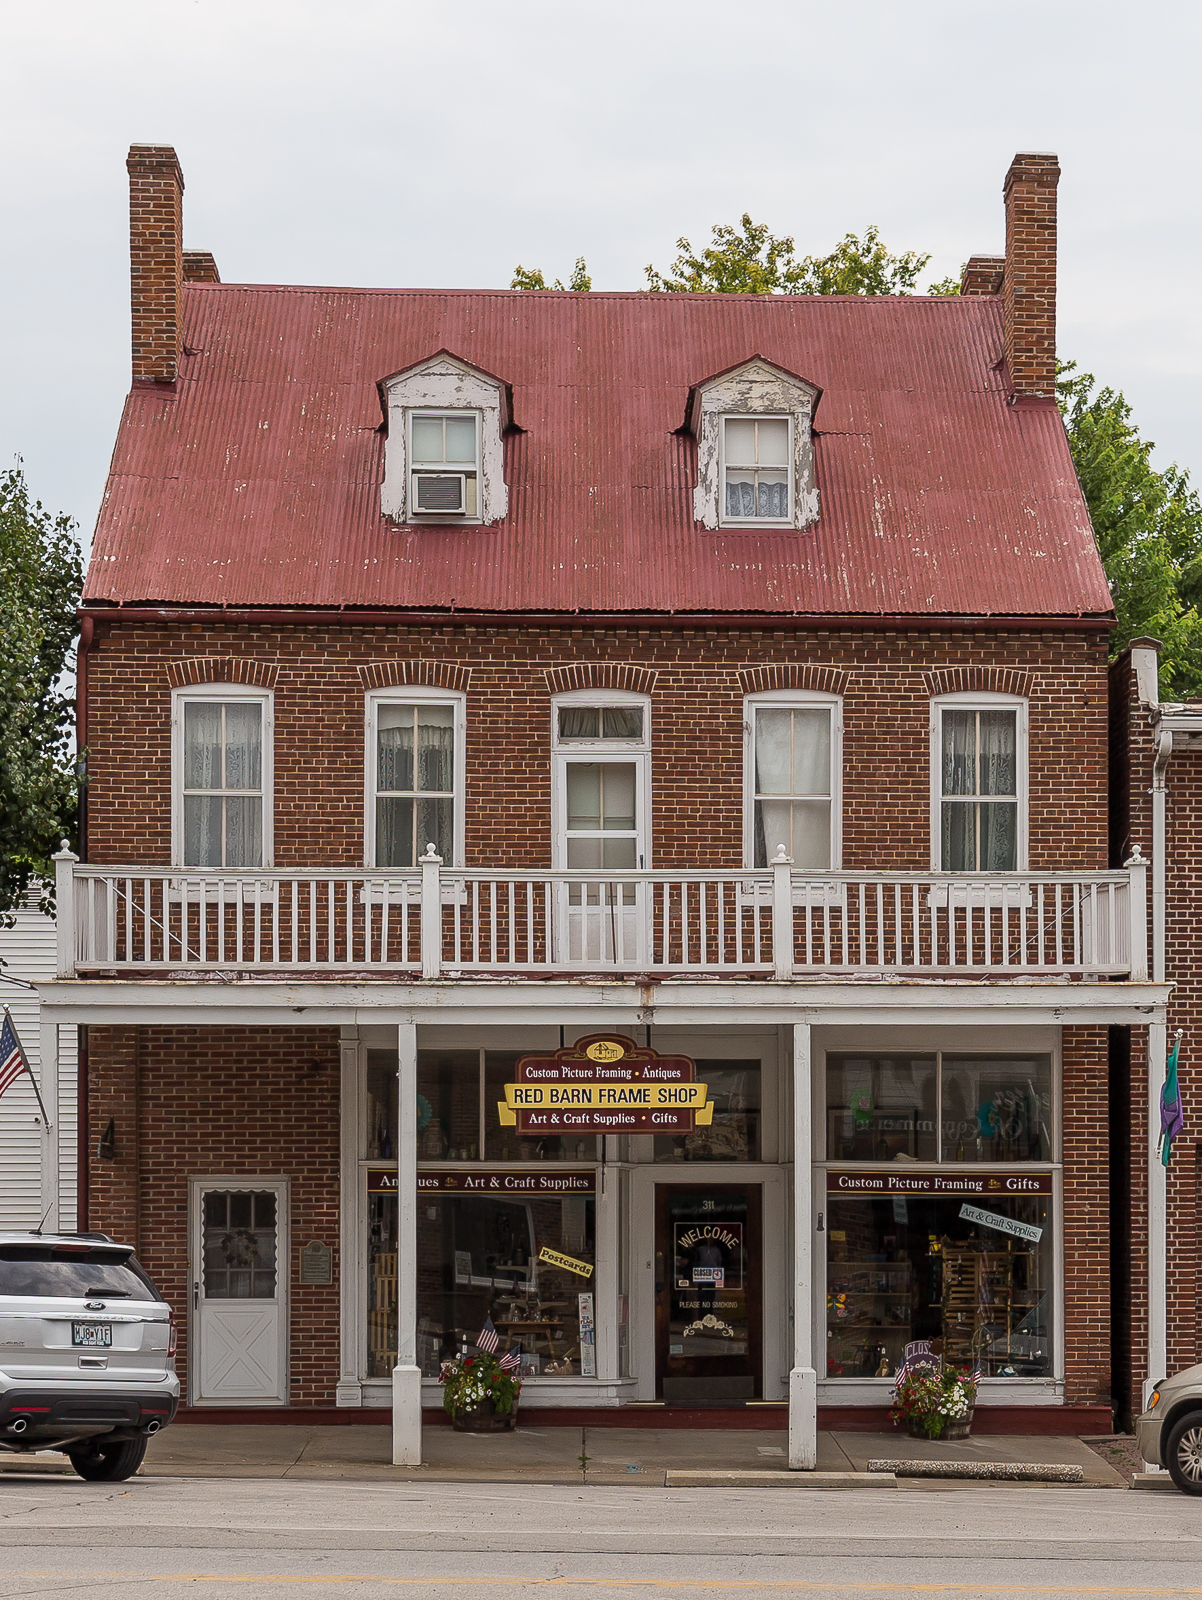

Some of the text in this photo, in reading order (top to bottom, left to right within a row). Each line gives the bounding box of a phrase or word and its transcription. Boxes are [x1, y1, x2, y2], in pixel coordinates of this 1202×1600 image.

[526, 1066, 681, 1080] Custom Picture Framing Antiques
[513, 1087, 698, 1104] RED BARN FRAME SHOP
[529, 1113, 678, 1126] Art & Craft Supplies Gifts
[380, 1175, 589, 1190] Anues Art & Craft Supplies
[838, 1176, 1040, 1191] Custom Picture Framing Gifts
[702, 1200, 715, 1210] 311
[961, 1206, 1038, 1239] Art & Craft Supplies
[678, 1225, 740, 1250] WELCOME
[540, 1248, 591, 1276] Postcards
[712, 1301, 738, 1309] SMOKING
[75, 1327, 110, 1341] MJ8 Y1F
